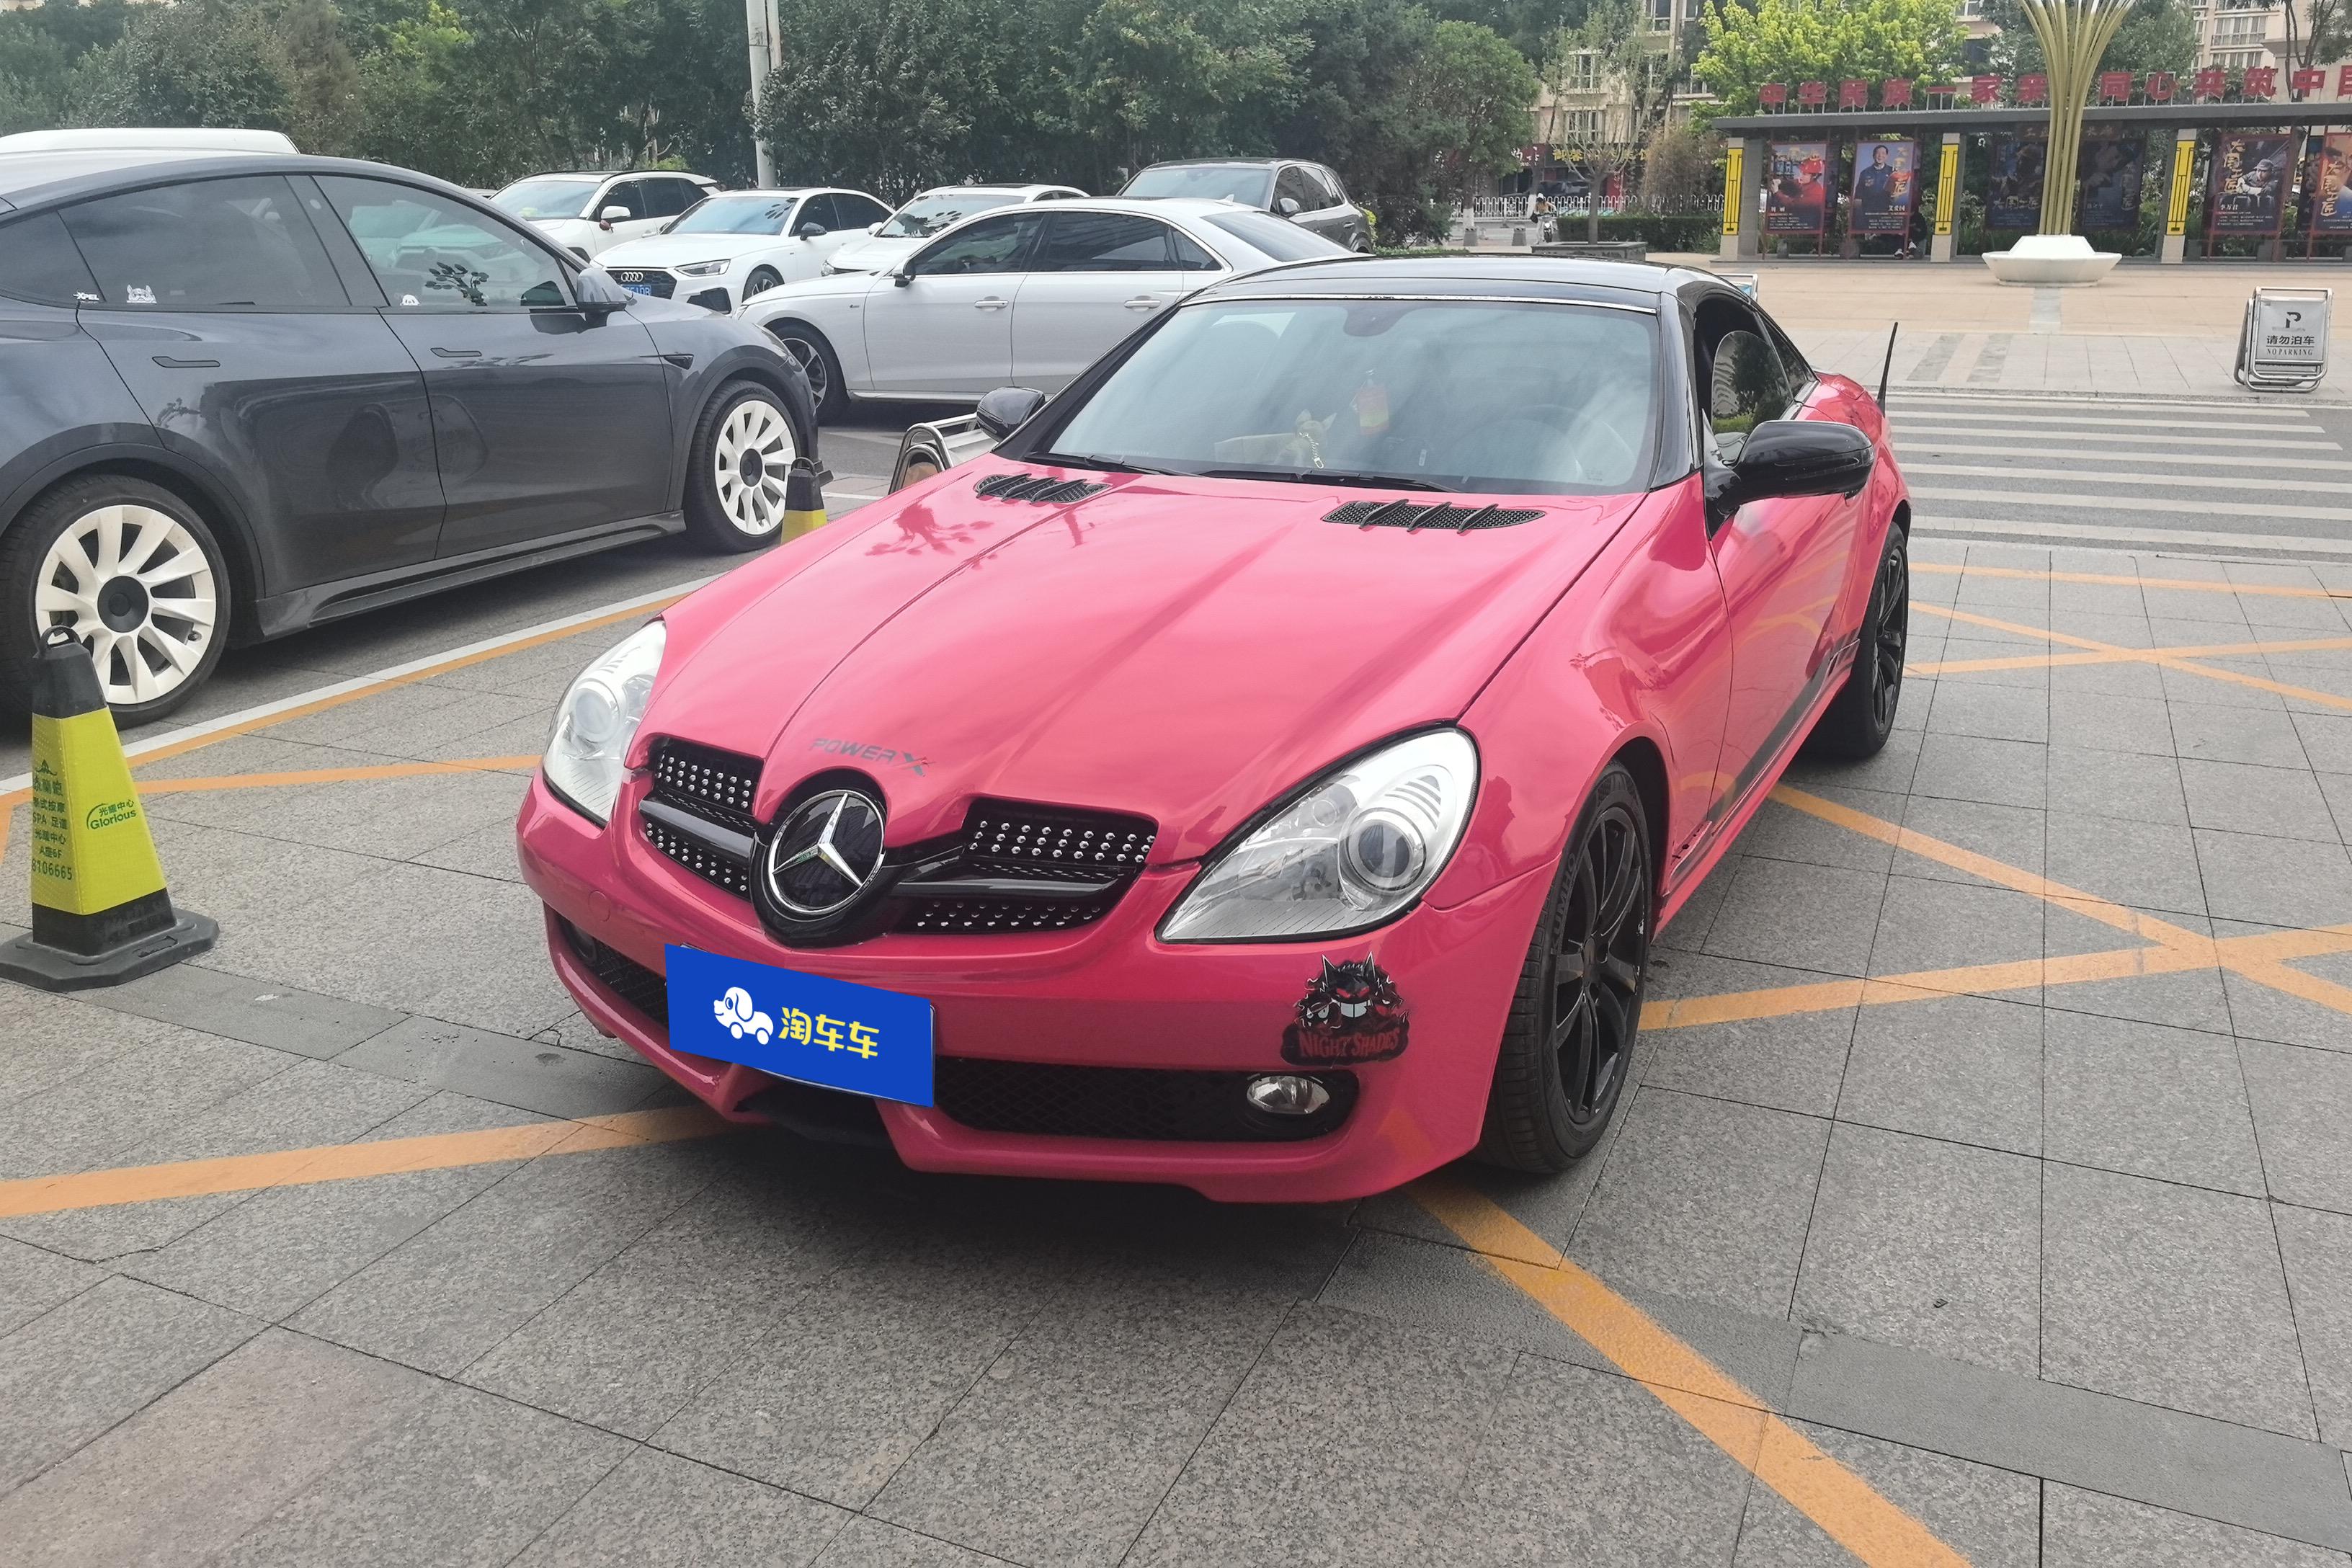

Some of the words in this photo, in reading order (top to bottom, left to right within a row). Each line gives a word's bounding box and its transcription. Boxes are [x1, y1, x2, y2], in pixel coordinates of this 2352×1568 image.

[1759, 74, 2049, 110] 中华民族一家亲
[2266, 335, 2315, 345] 请勿泊车
[808, 737, 899, 762] POWER
[32, 812, 47, 825] SPA
[90, 809, 137, 830] Glorious
[1550, 852, 1577, 956] KUMHO
